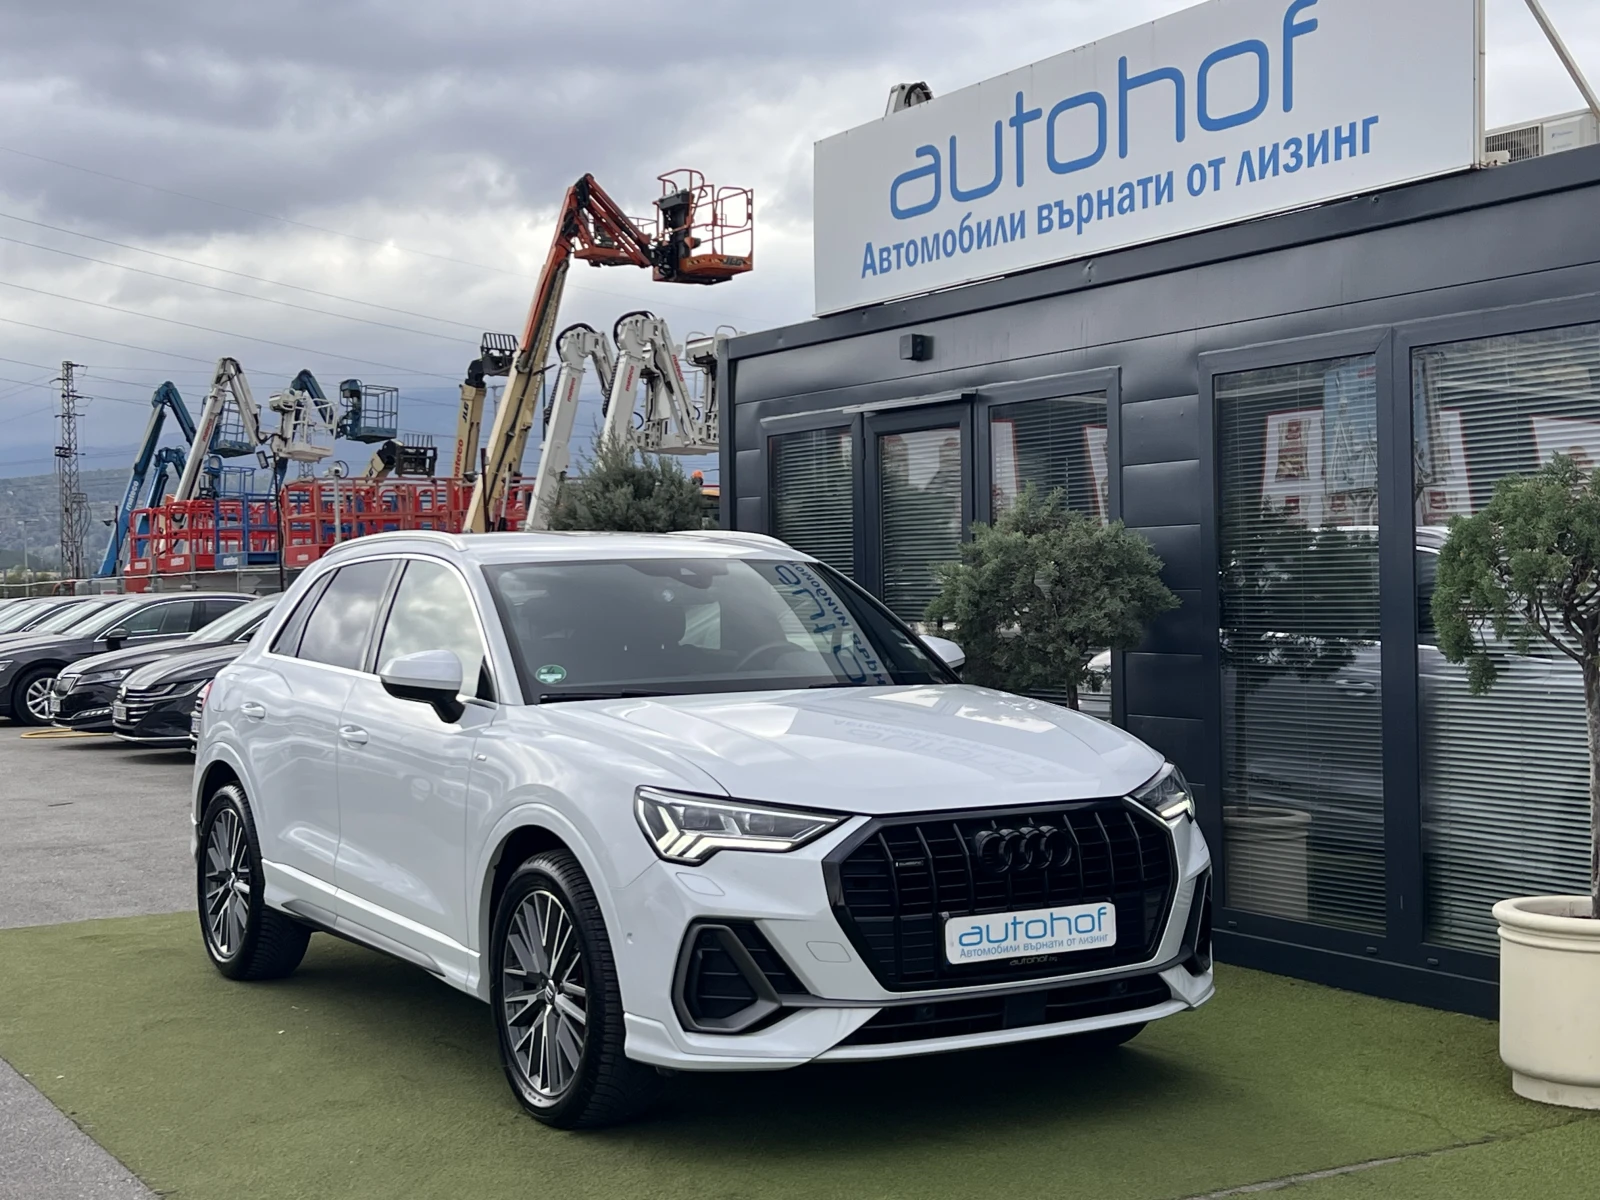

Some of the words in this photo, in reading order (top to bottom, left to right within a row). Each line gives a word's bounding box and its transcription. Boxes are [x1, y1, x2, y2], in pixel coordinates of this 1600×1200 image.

[890, 0, 1318, 220] autohof
[861, 210, 1026, 279] Автомобили
[1037, 171, 1174, 236] върнати
[1186, 156, 1226, 197] от
[1235, 115, 1379, 186] лизинг
[125, 480, 140, 511] mateco
[958, 906, 1107, 946] autohof
[959, 943, 1020, 958] Автомобили
[1023, 940, 1064, 952] върнати
[1067, 937, 1077, 947] от
[1078, 933, 1108, 946] лизинг
